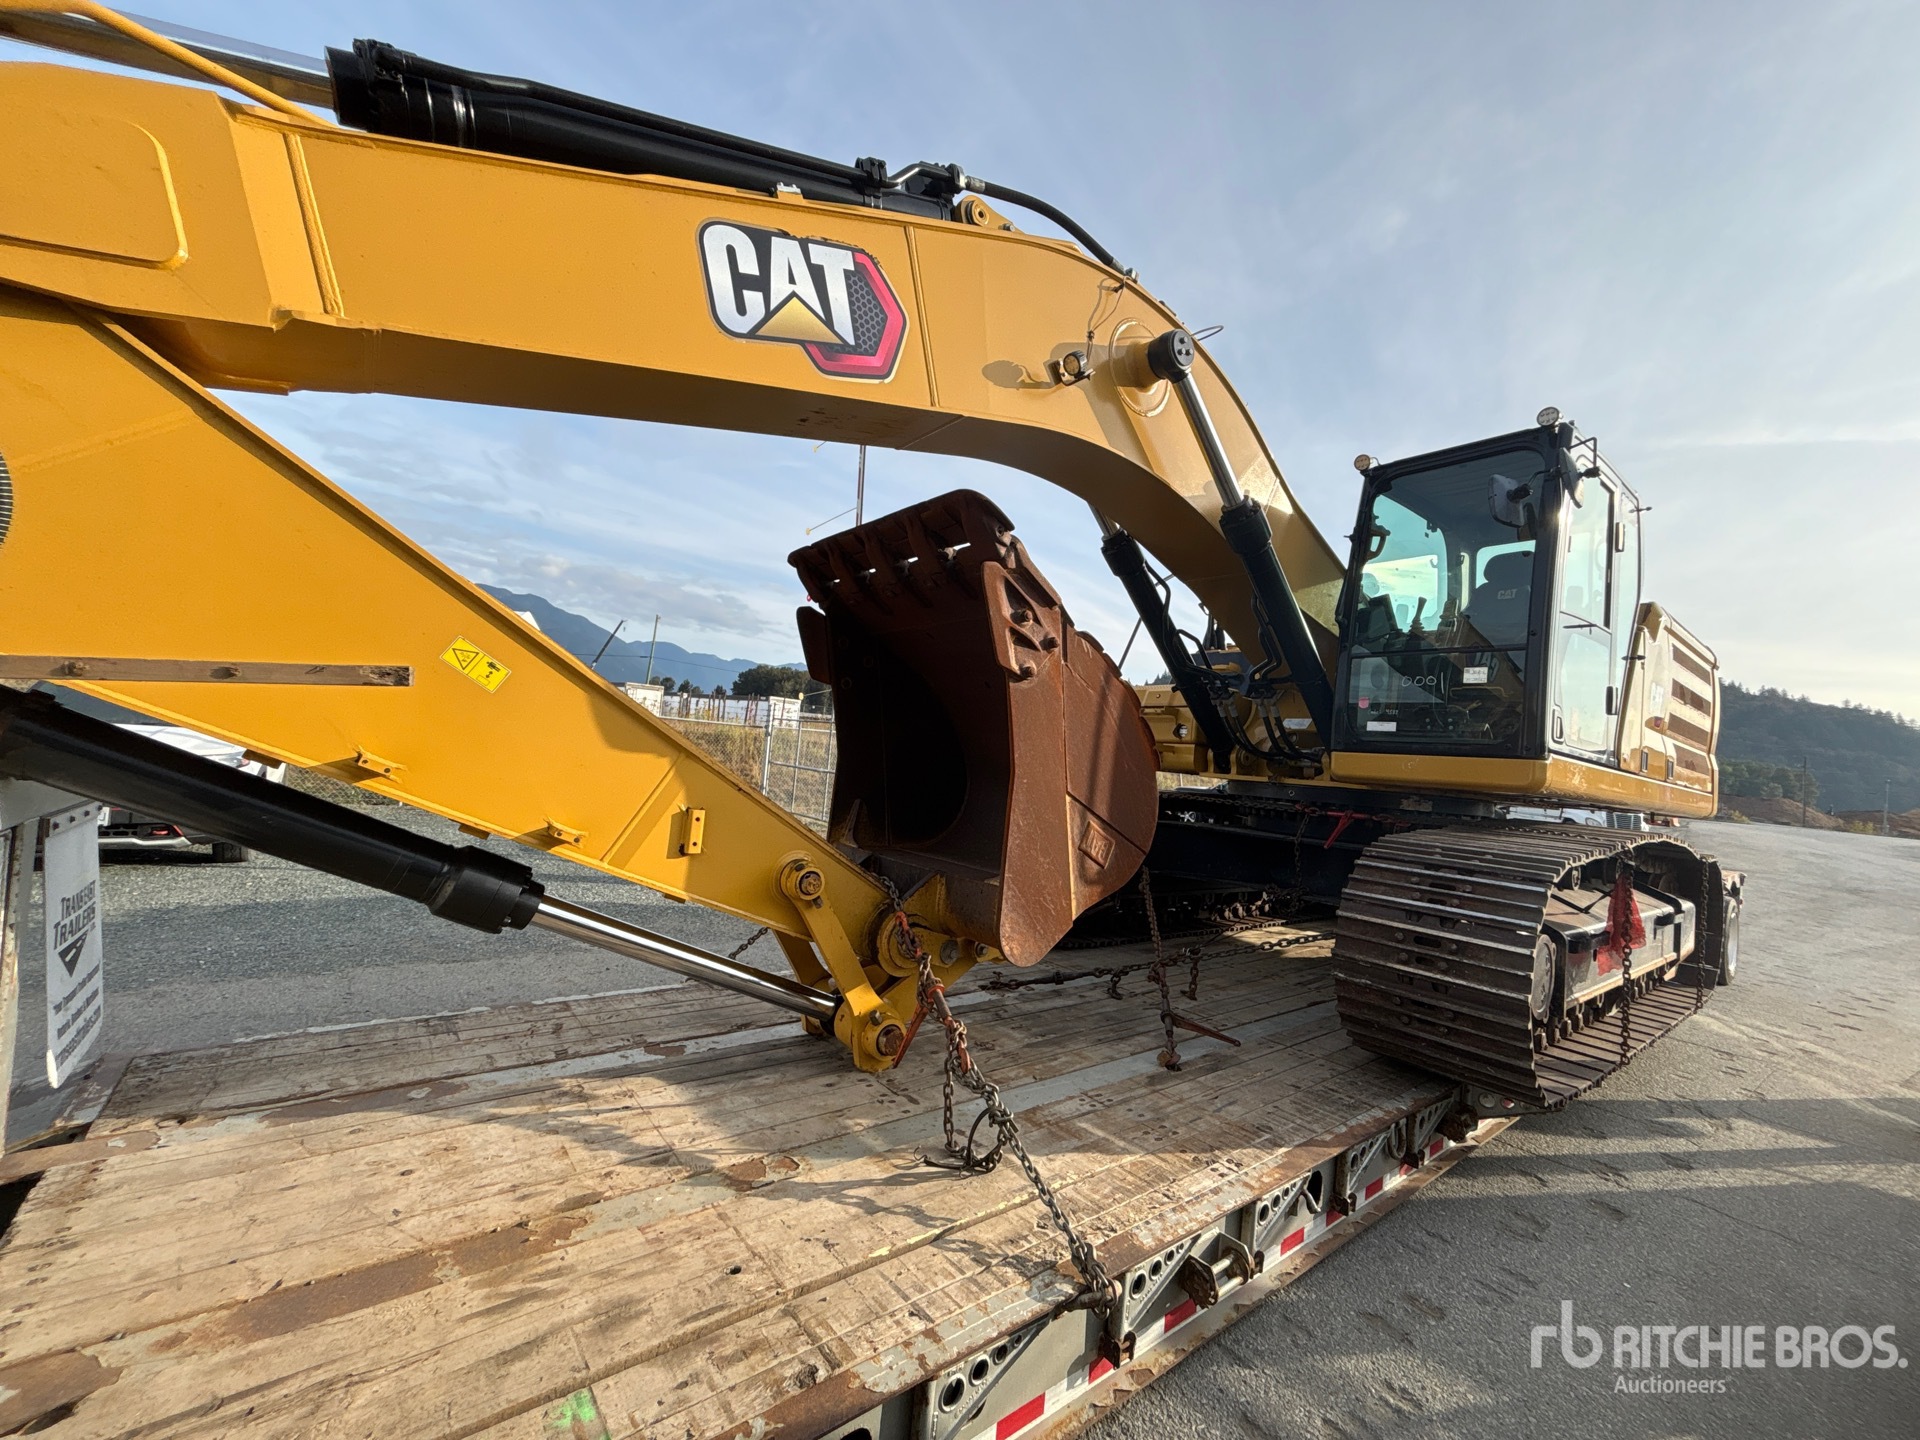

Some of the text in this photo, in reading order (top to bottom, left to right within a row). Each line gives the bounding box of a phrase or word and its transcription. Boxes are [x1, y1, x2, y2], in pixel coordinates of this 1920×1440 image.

[703, 224, 855, 346] CAT
[1497, 588, 1518, 600] CAT
[53, 901, 96, 950] TRAILERS
